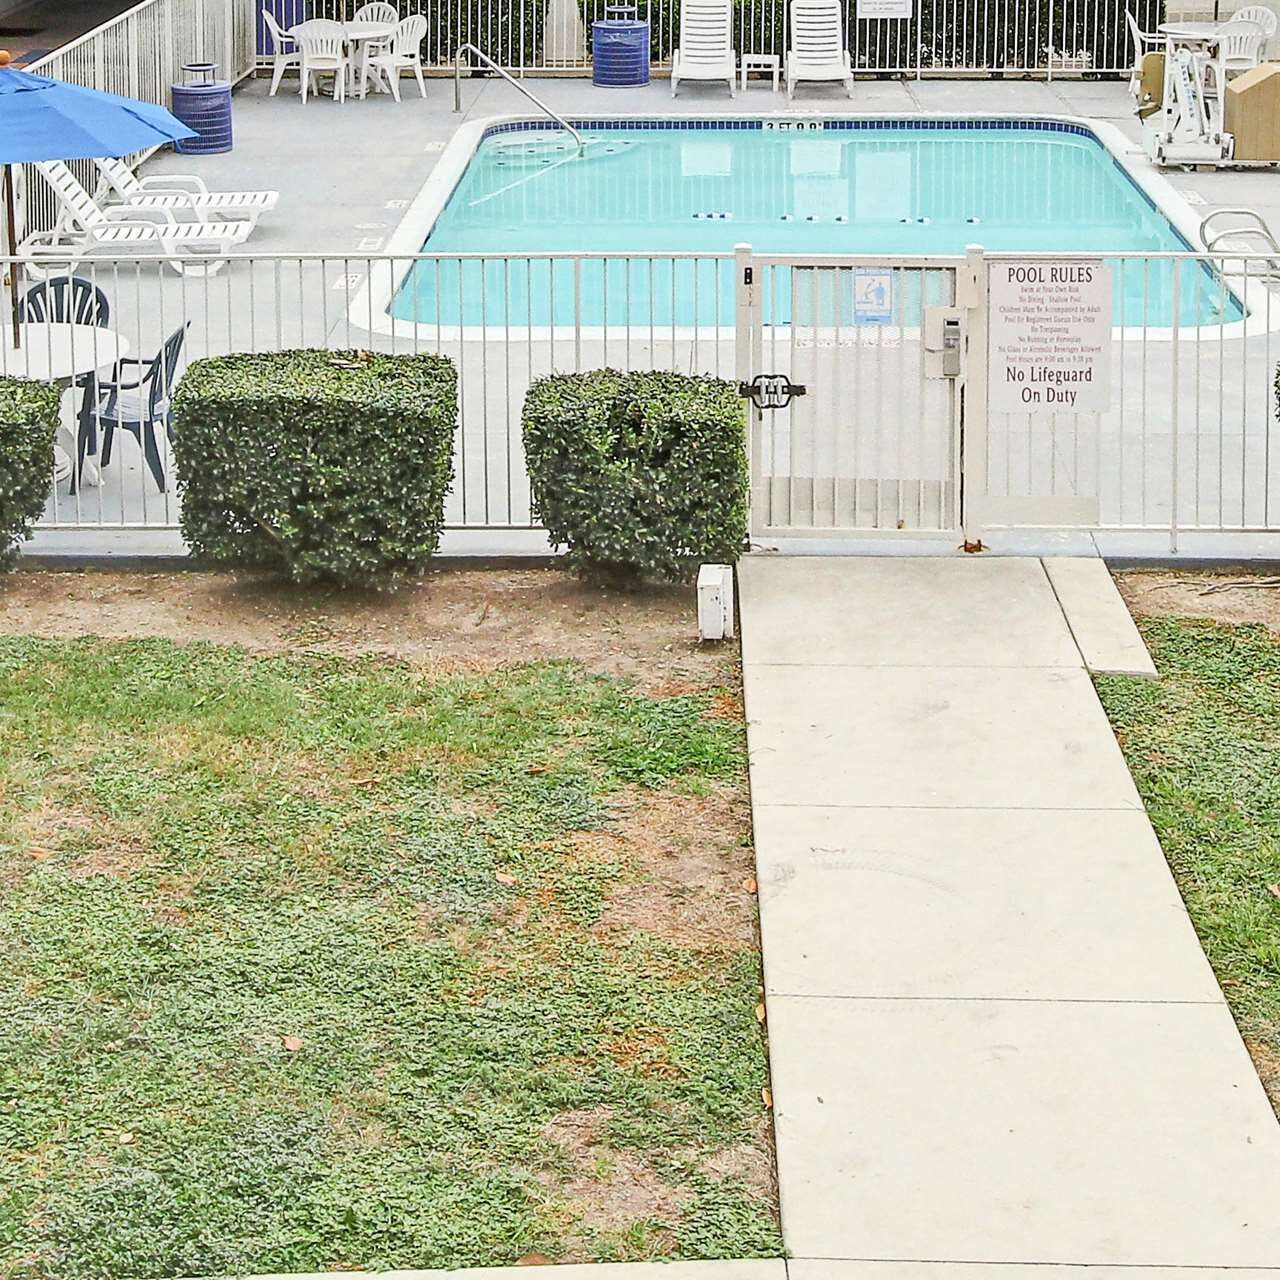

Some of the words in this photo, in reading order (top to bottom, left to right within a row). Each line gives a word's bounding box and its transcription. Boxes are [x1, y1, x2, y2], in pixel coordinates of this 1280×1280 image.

[1008, 267, 1045, 283] POOL
[1051, 267, 1093, 283] RULES
[1007, 366, 1025, 382] No
[1030, 366, 1092, 385] Lifeguard
[1022, 387, 1040, 403] On
[1046, 387, 1077, 407] Duty
